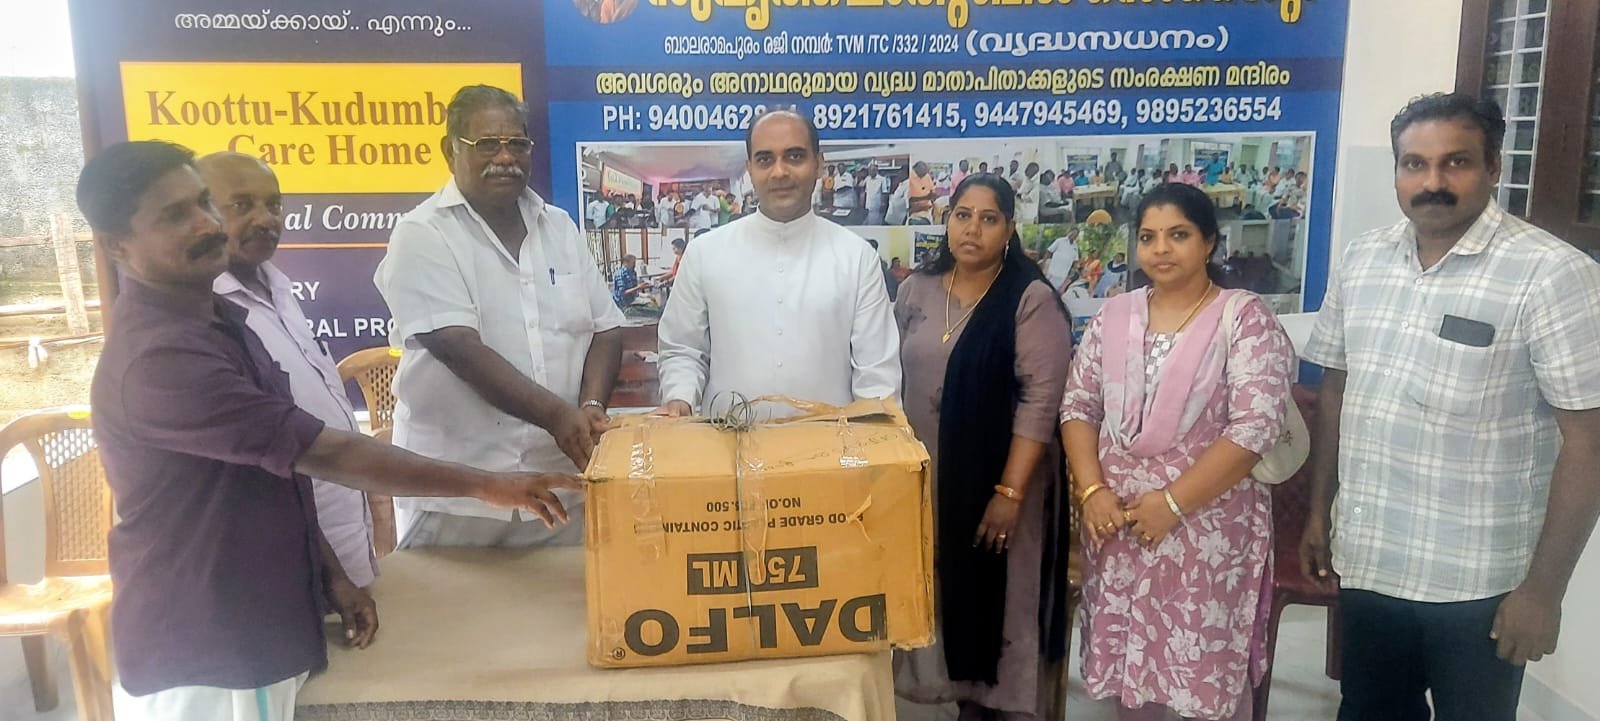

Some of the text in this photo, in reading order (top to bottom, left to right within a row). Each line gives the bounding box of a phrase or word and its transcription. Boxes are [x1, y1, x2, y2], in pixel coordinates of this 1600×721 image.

[664, 35, 760, 60] ബാലരാമപുരം
[763, 31, 788, 55] രജി
[836, 34, 864, 53] TVM
[929, 33, 959, 53] 2024
[596, 71, 704, 98] അവശരും
[709, 70, 857, 97] അനാഥരുമായ
[922, 66, 1104, 95] മാതാപിതാക്കളുടെ
[1110, 64, 1220, 89] സംരക്ഷണ
[1225, 61, 1291, 87] മന്ദിരം
[146, 90, 447, 126] Koottu-Kudumb
[603, 96, 1281, 131] PH: 9400462 8921761415, 9447945469, 9895236554
[325, 134, 432, 166] Home
[780, 514, 824, 528] GRADE
[693, 559, 738, 587] ML
[624, 594, 888, 656] DALFO
